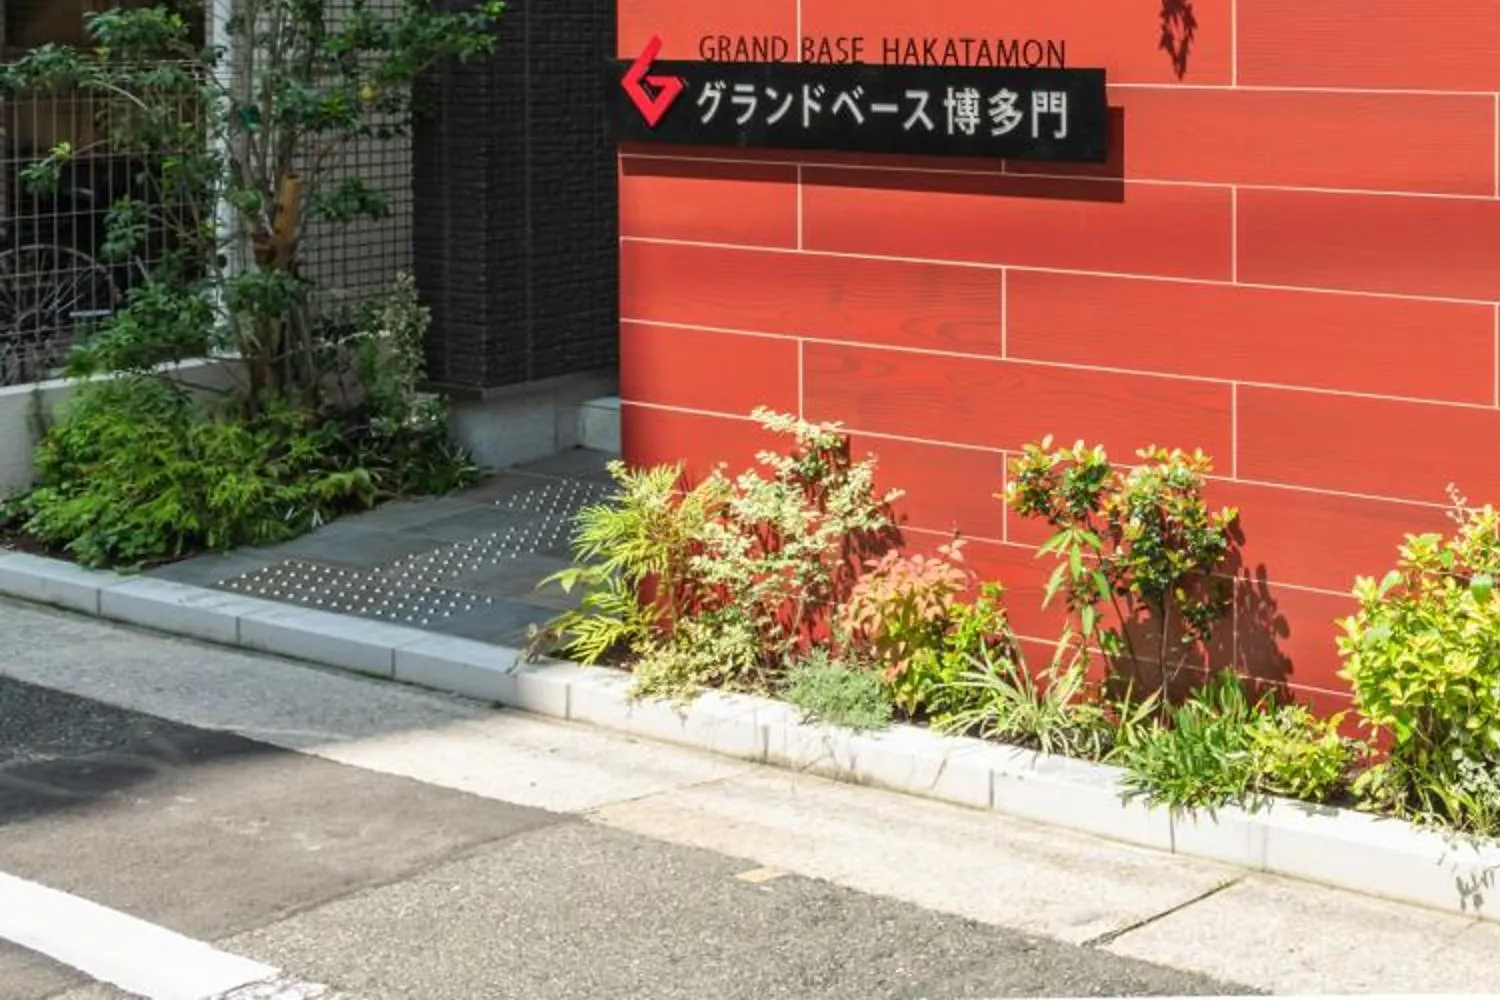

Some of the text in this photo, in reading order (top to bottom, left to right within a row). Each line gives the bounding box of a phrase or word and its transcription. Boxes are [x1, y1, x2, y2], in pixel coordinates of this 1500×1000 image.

[699, 35, 1066, 69] GRAND BASE HAKATAMON
[697, 80, 1068, 139] グランドベース博多門
